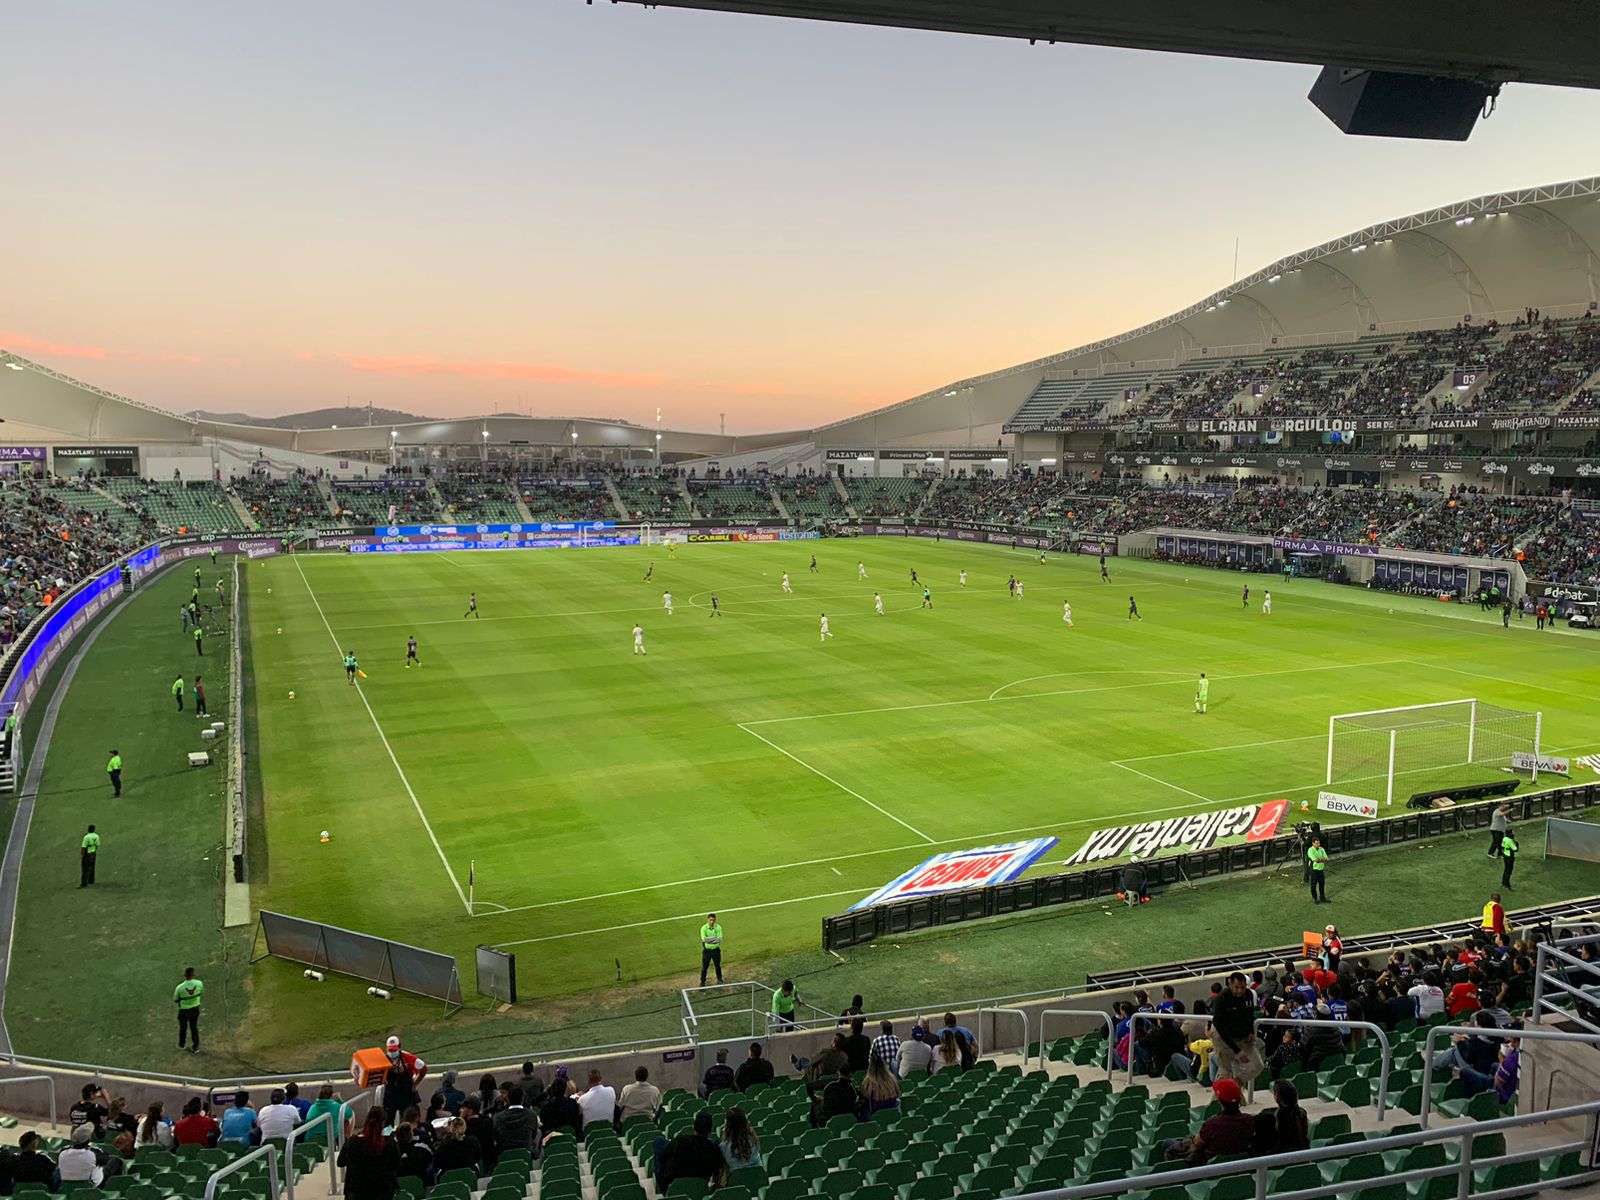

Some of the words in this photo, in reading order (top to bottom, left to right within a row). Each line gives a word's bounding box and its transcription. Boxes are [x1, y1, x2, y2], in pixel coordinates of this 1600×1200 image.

[1463, 375, 1476, 385] 03
[1202, 420, 1216, 432] EL
[1219, 420, 1257, 432] GRAN
[1344, 421, 1357, 430] DE
[1366, 421, 1382, 429] SER
[1430, 420, 1478, 428] MAZATLAN
[1274, 540, 1307, 550] PIRMA
[1325, 545, 1360, 555] PIRMA
[1319, 793, 1336, 801] LIGA
[1327, 800, 1358, 812] BBVA
[1062, 804, 1257, 866] caliente.mx
[900, 852, 1015, 892] BIMBO
